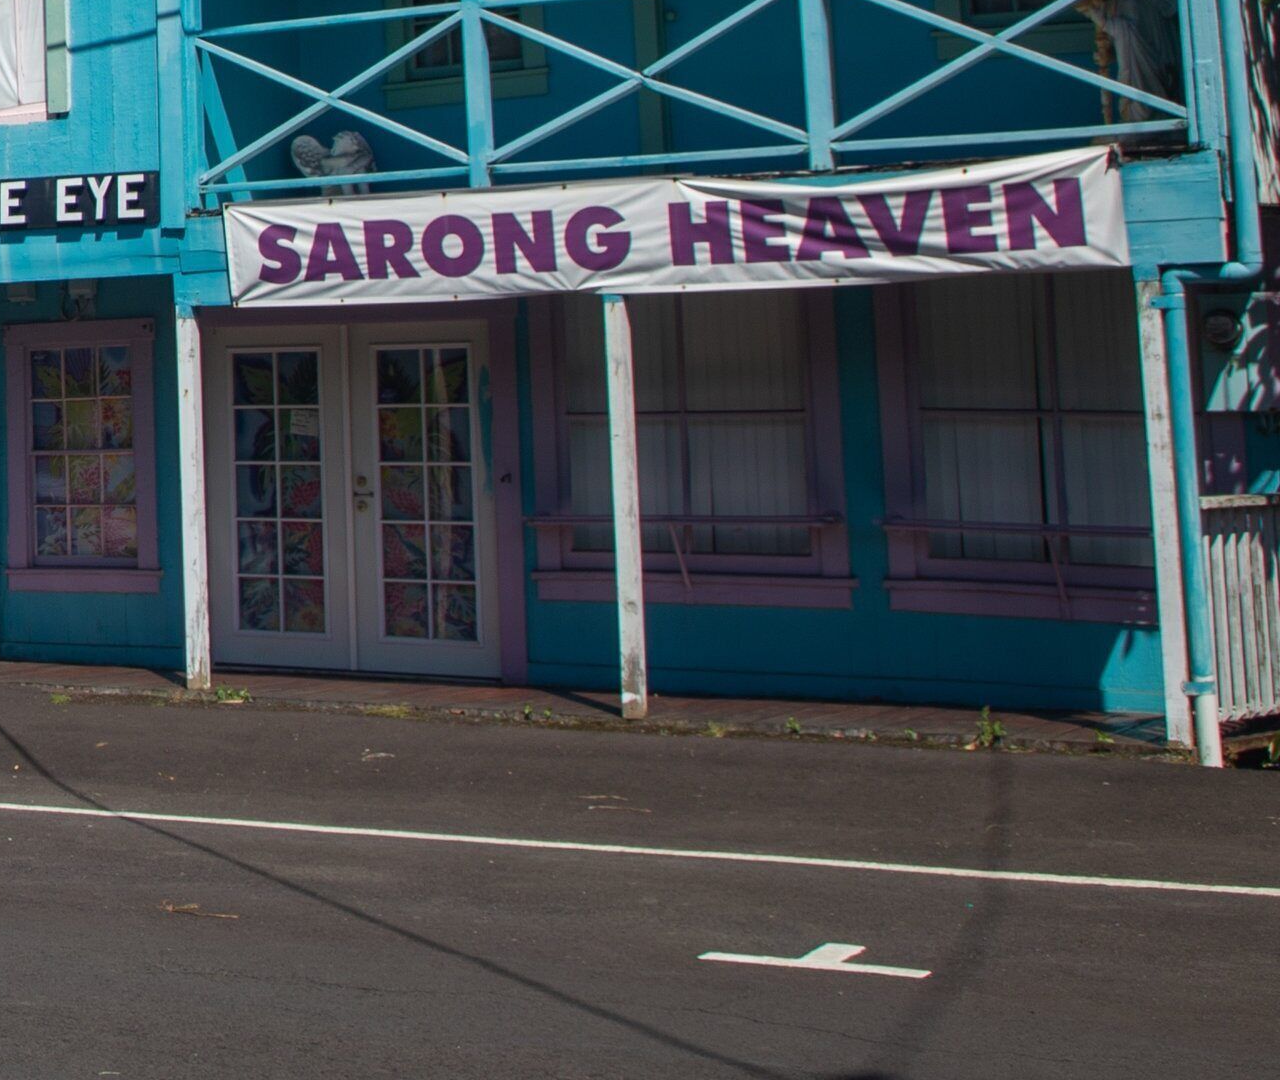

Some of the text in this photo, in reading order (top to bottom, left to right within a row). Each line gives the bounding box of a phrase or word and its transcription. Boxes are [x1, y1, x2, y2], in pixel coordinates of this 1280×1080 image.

[56, 173, 146, 222] EYE
[257, 177, 1088, 285] SARONG HEAVEN
